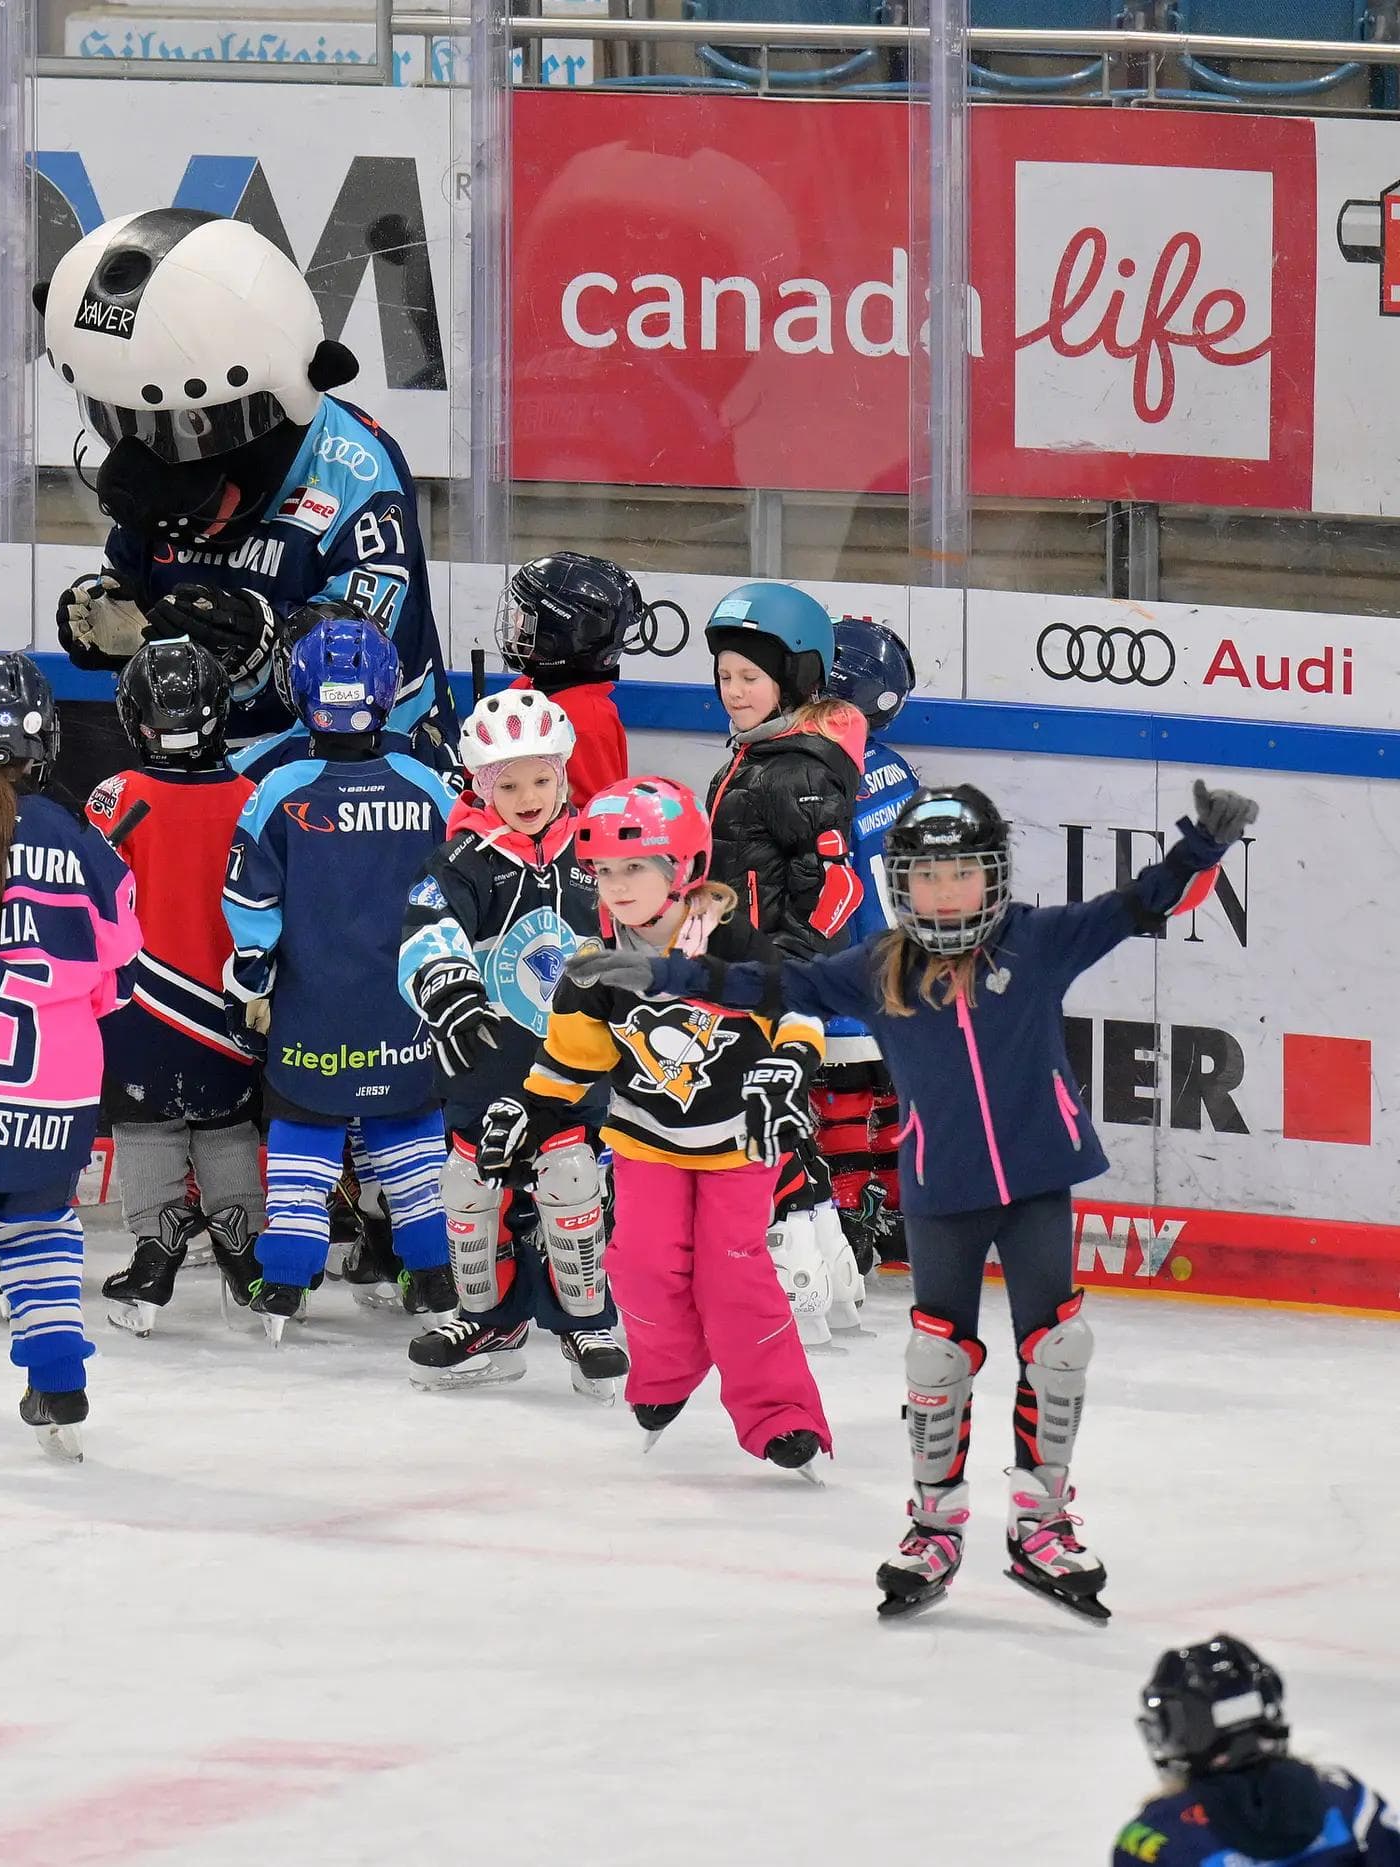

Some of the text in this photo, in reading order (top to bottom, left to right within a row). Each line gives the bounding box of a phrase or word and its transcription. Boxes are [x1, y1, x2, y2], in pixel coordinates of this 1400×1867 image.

[79, 298, 135, 333] XAVER
[1016, 227, 1273, 424] life
[1202, 639, 1355, 696] Audi
[321, 688, 360, 700] TOBIAS
[347, 785, 386, 793] BAUER
[4, 843, 86, 886] TURN
[281, 1041, 434, 1077] zieglerhaus
[563, 1209, 600, 1227] CCM
